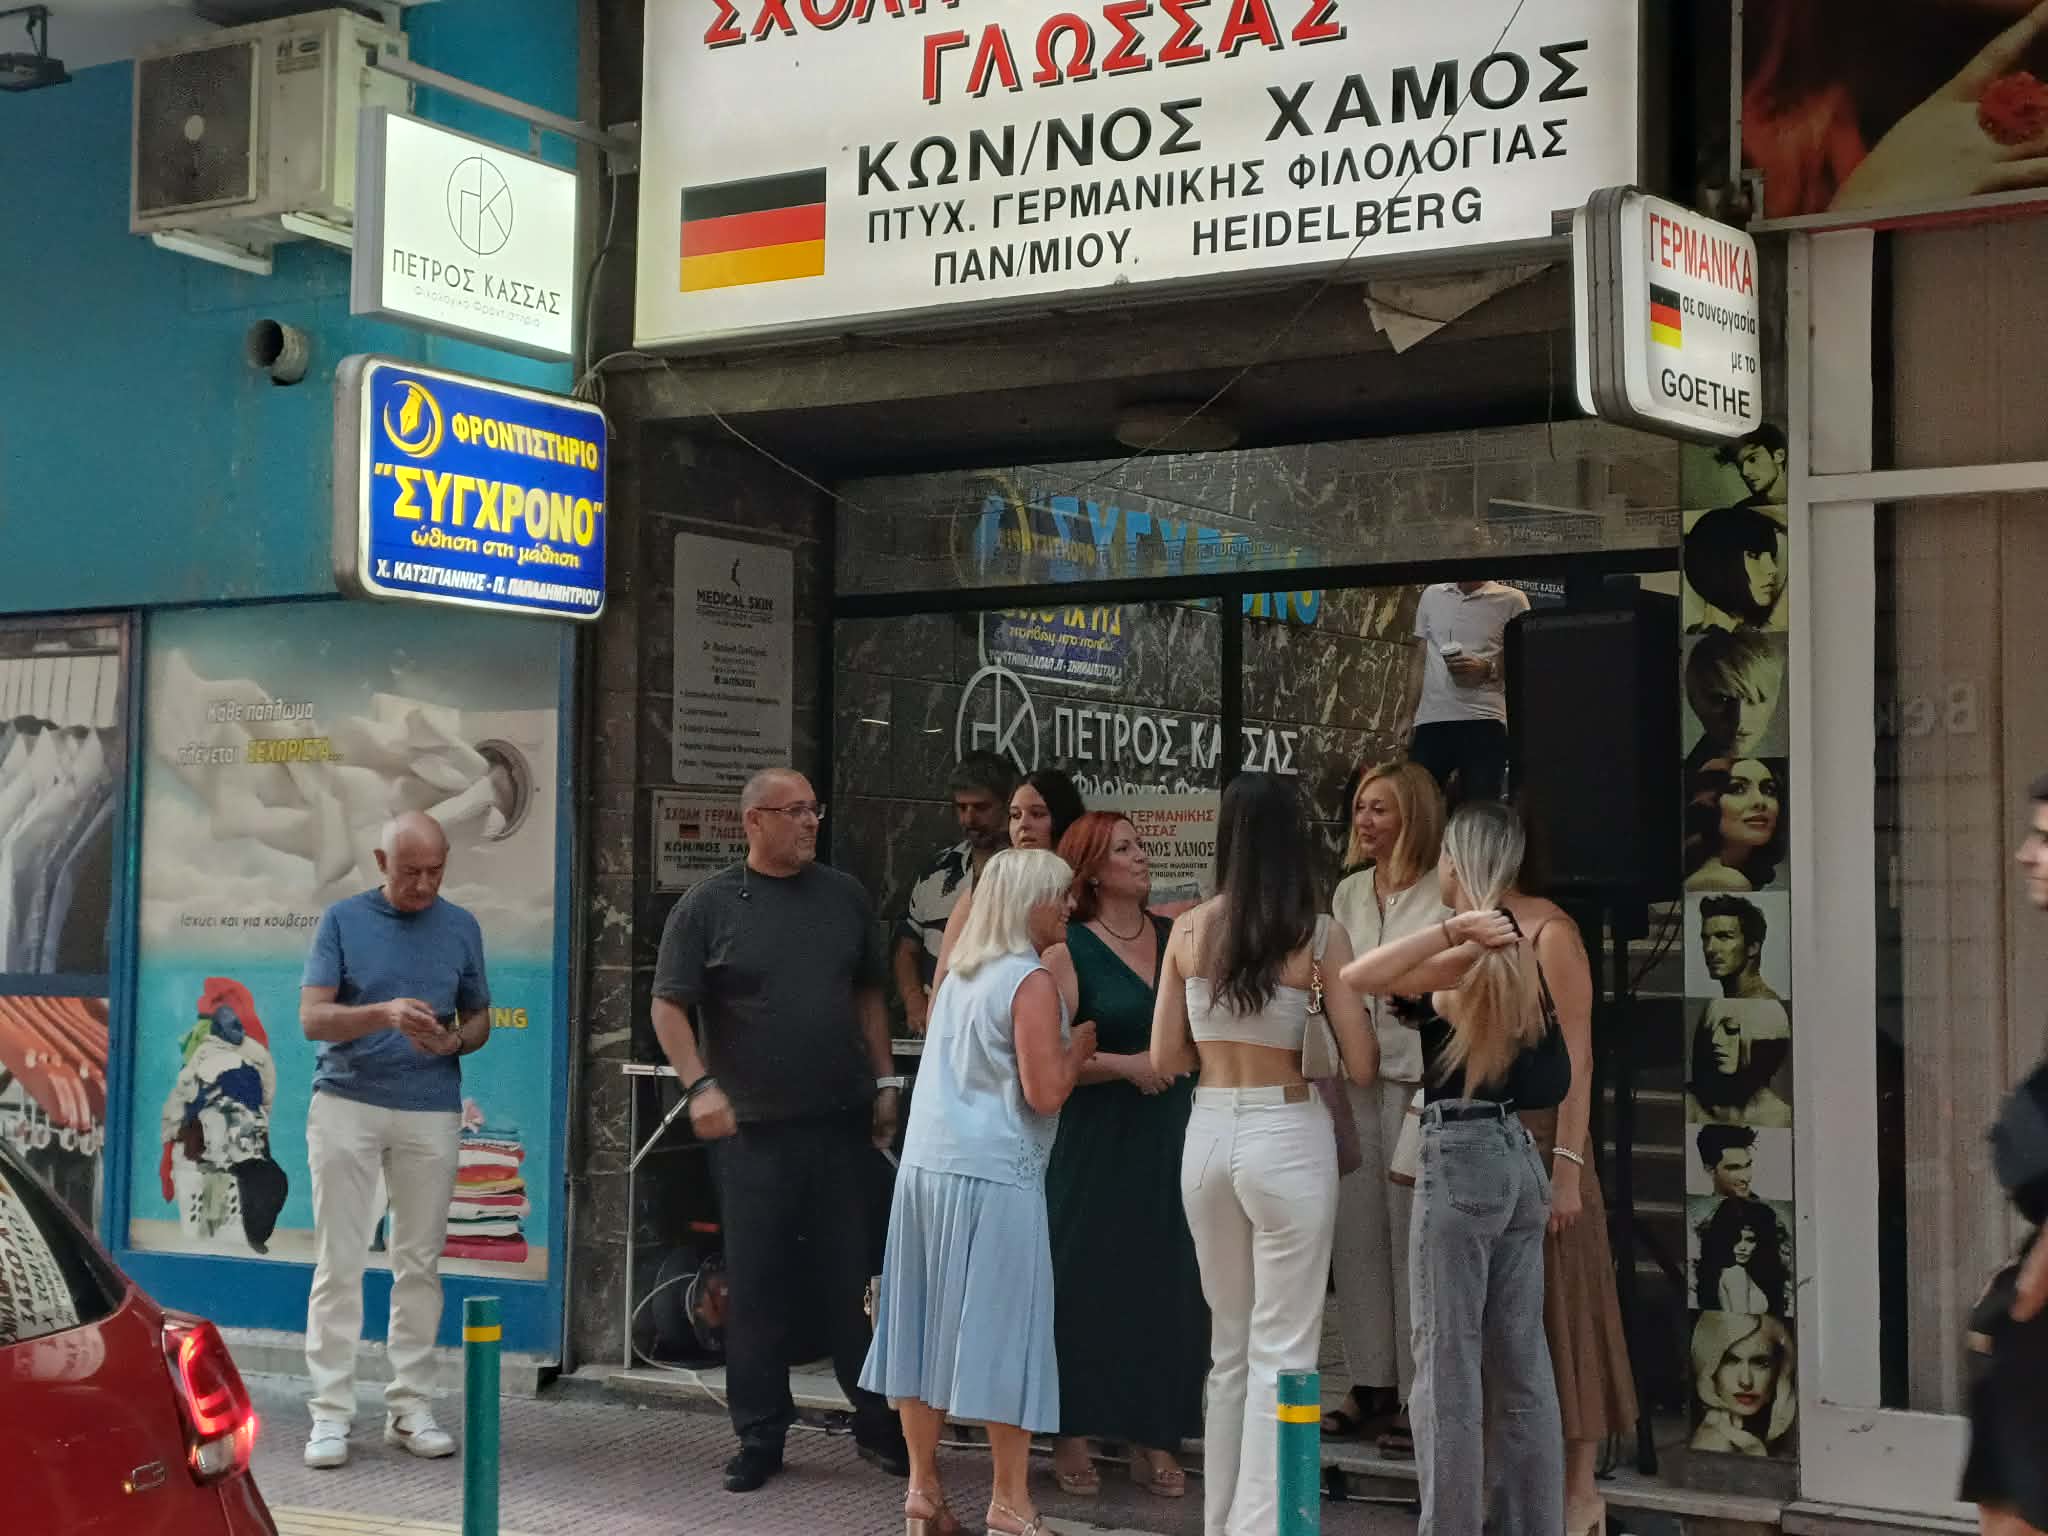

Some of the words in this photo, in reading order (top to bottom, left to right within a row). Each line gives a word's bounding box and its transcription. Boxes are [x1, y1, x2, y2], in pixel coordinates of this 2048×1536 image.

[922, 0, 1347, 104] ΓΛΩΣΣΑΣ
[857, 98, 1202, 195] ΚΩΝ/ΝΟΣ
[1265, 40, 1589, 142] ΧΑΜΟΣ
[868, 202, 976, 243] ΠΤΥΧ.
[993, 159, 1265, 229] ΓΕΡΜΑΝΙΚΗΣ
[1288, 119, 1568, 190] ΦΙΛΟΛΟΓΙΑΣ
[1193, 186, 1483, 256] HEIDELBERG
[393, 249, 475, 292] ΠΕΤΡΟΣ
[484, 273, 561, 315] ΚΑΣΣΑΣ
[934, 228, 1132, 287] ΠΑΝ/ΜΙΟΥ
[1649, 212, 1754, 296] ΓΕΡΜΑΝΙΚΑ
[1682, 296, 1695, 315] σε
[1697, 304, 1756, 335] συνεργασία
[1731, 351, 1742, 374] με
[1744, 355, 1756, 374] το
[1661, 368, 1752, 419] GOETHE
[452, 412, 599, 471] ΦΡΟΝΤΙΣΤΗΡΙΟ
[410, 524, 478, 553] ώθηση
[483, 541, 514, 559] στη
[517, 541, 581, 568] μάθηση
[1055, 707, 1178, 767] ΠΕΤΡΟΣ
[1190, 722, 1298, 775] ΚΑΣΑΣ
[1131, 809, 1215, 823] ΓΕΡΜΑΝΙΚΗΣ
[1135, 825, 1177, 837] ΩΣΣΑΣ
[1174, 841, 1215, 857] ΧΑΜΟΣ
